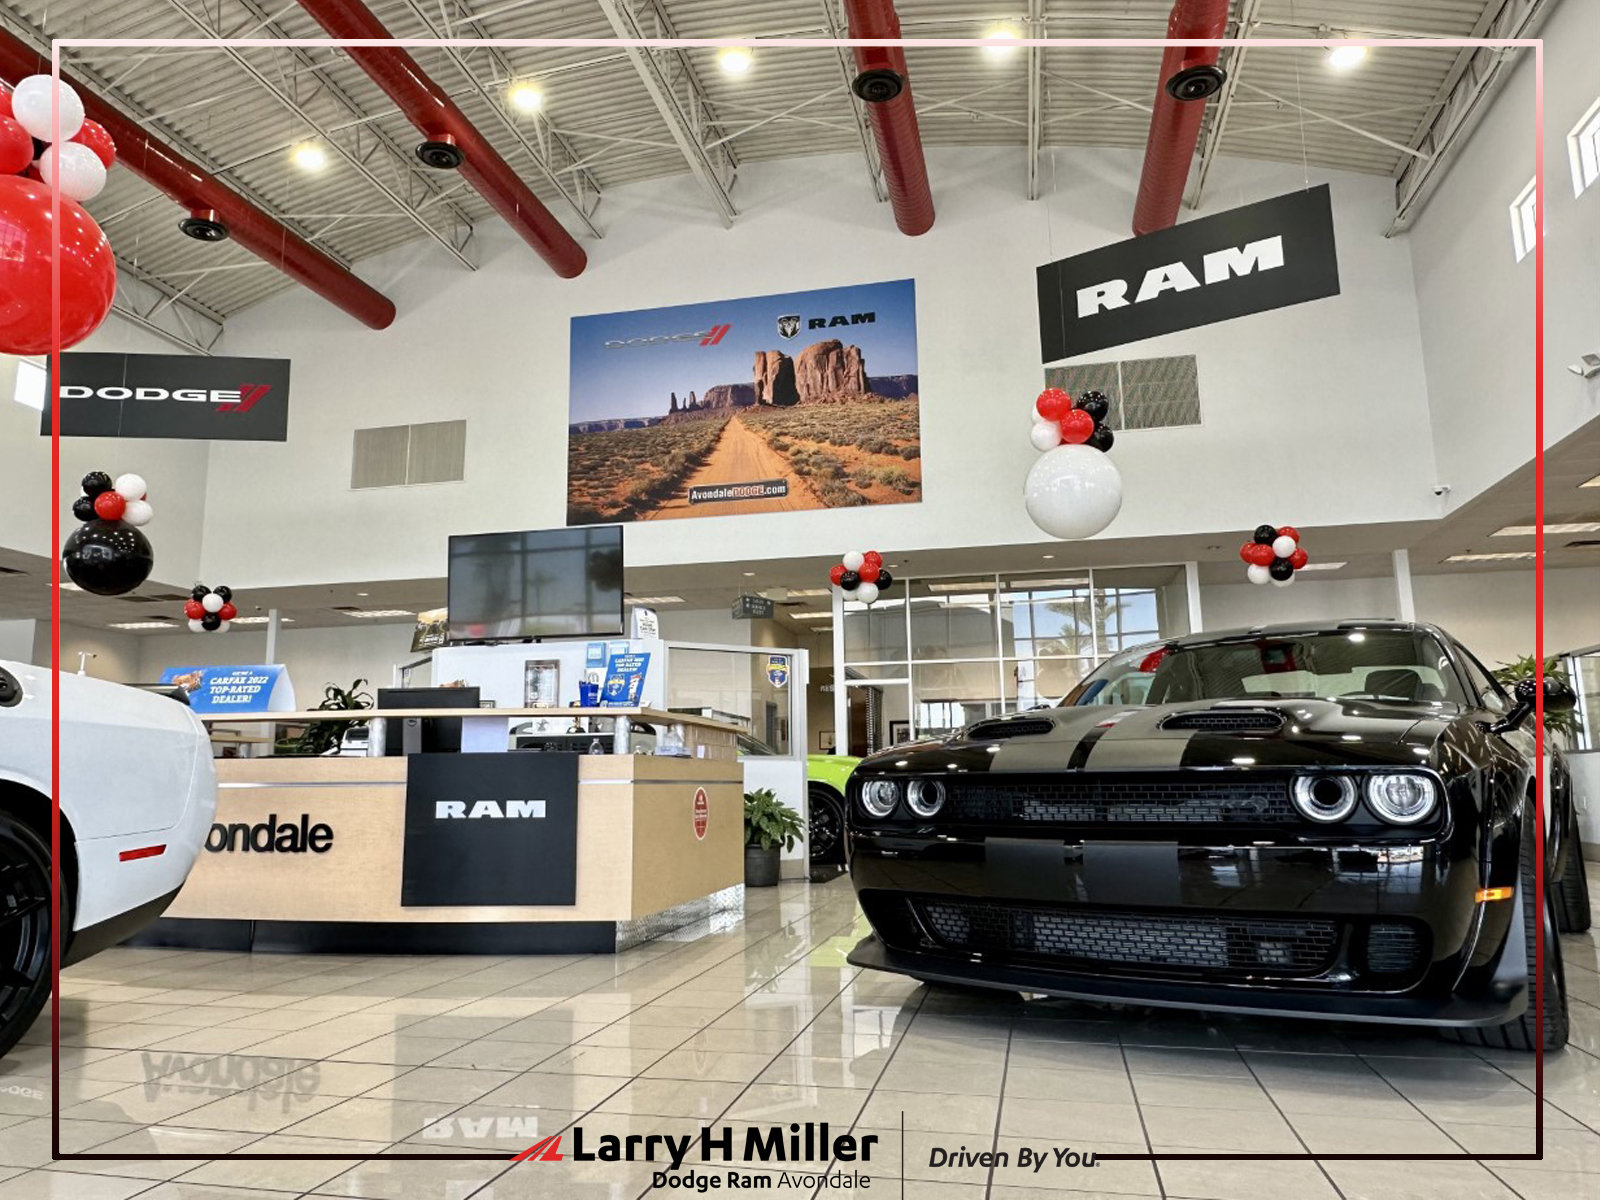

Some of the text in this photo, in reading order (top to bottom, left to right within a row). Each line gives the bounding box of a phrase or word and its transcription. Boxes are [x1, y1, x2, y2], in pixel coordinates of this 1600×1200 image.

[1076, 235, 1284, 318] RAM
[808, 312, 876, 330] RAM
[59, 386, 242, 403] DODGE
[210, 676, 268, 685] CARFAX 2022
[210, 685, 262, 694] TOP-RATED
[211, 695, 252, 704] DEALER!
[435, 800, 547, 819] RAM
